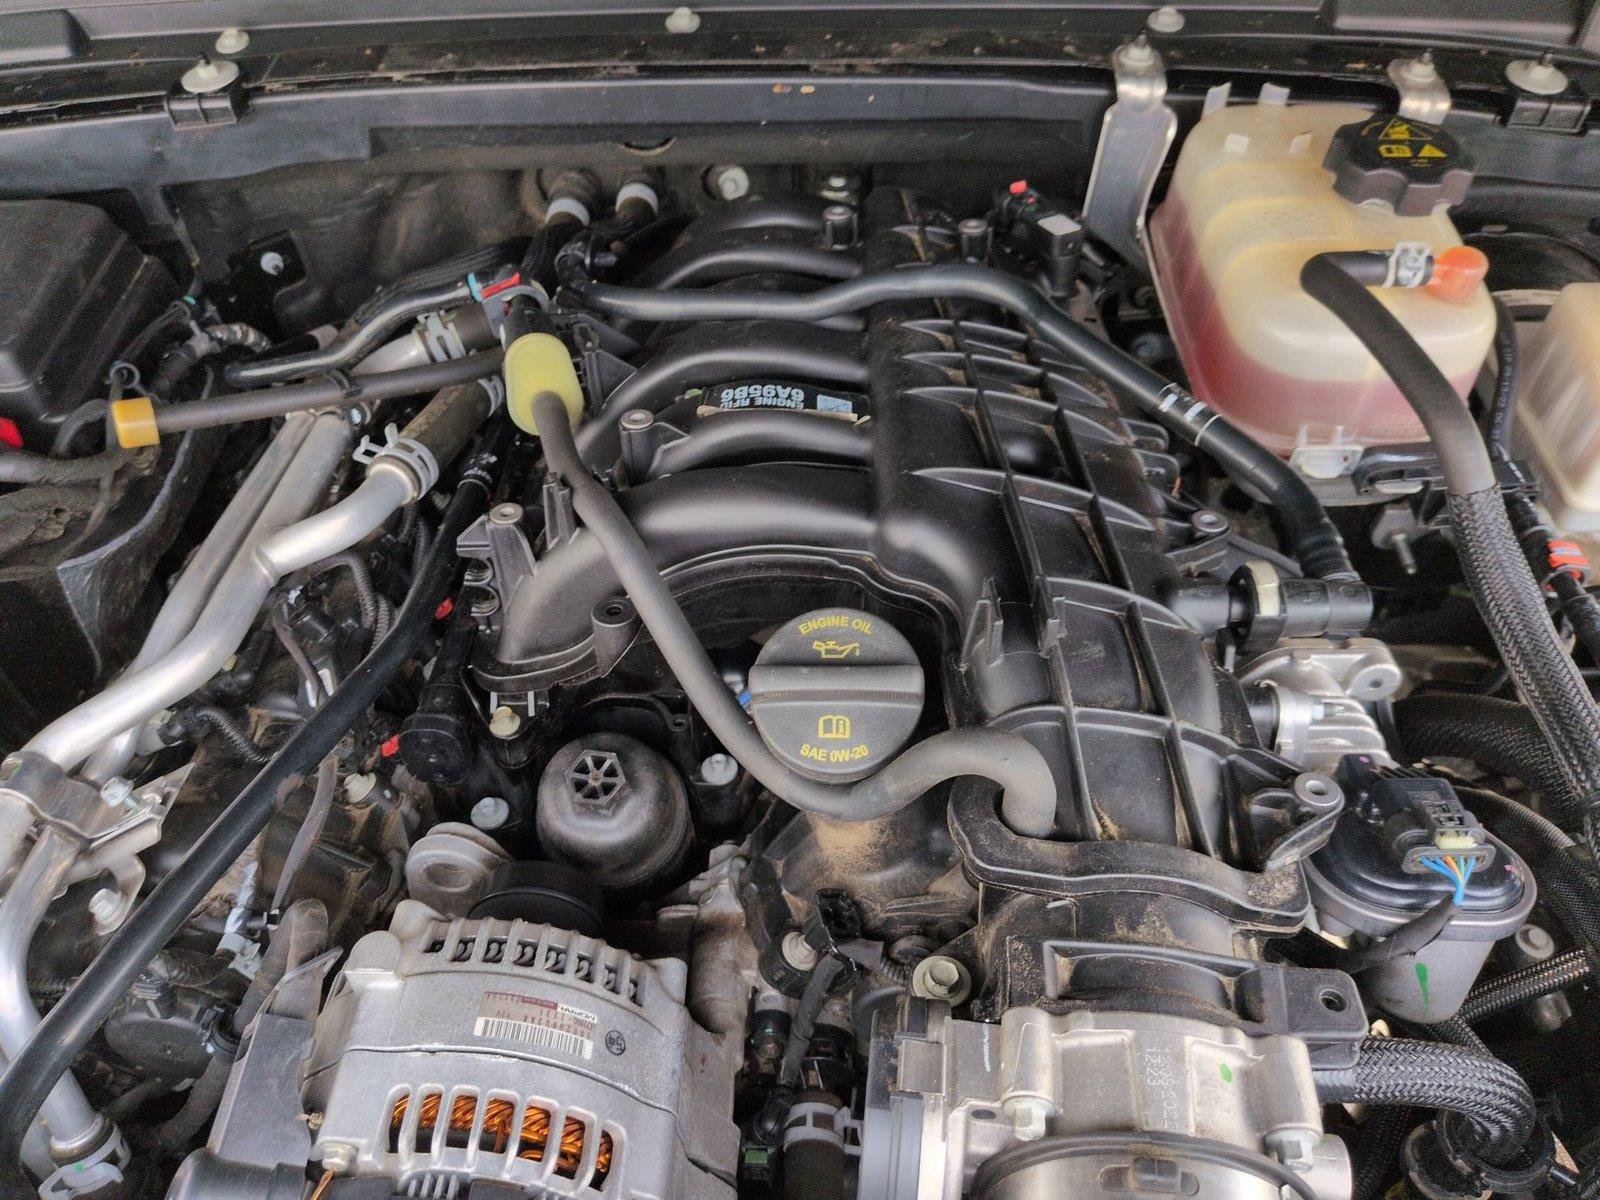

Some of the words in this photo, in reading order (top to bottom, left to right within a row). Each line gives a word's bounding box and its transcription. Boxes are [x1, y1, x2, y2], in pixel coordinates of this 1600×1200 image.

[721, 384, 805, 402] 6A95B6
[754, 396, 804, 410] ENGINE
[799, 615, 849, 634] ENGINE
[852, 618, 872, 634] OIL
[800, 744, 826, 761] SAE
[830, 744, 869, 762] 0W-20
